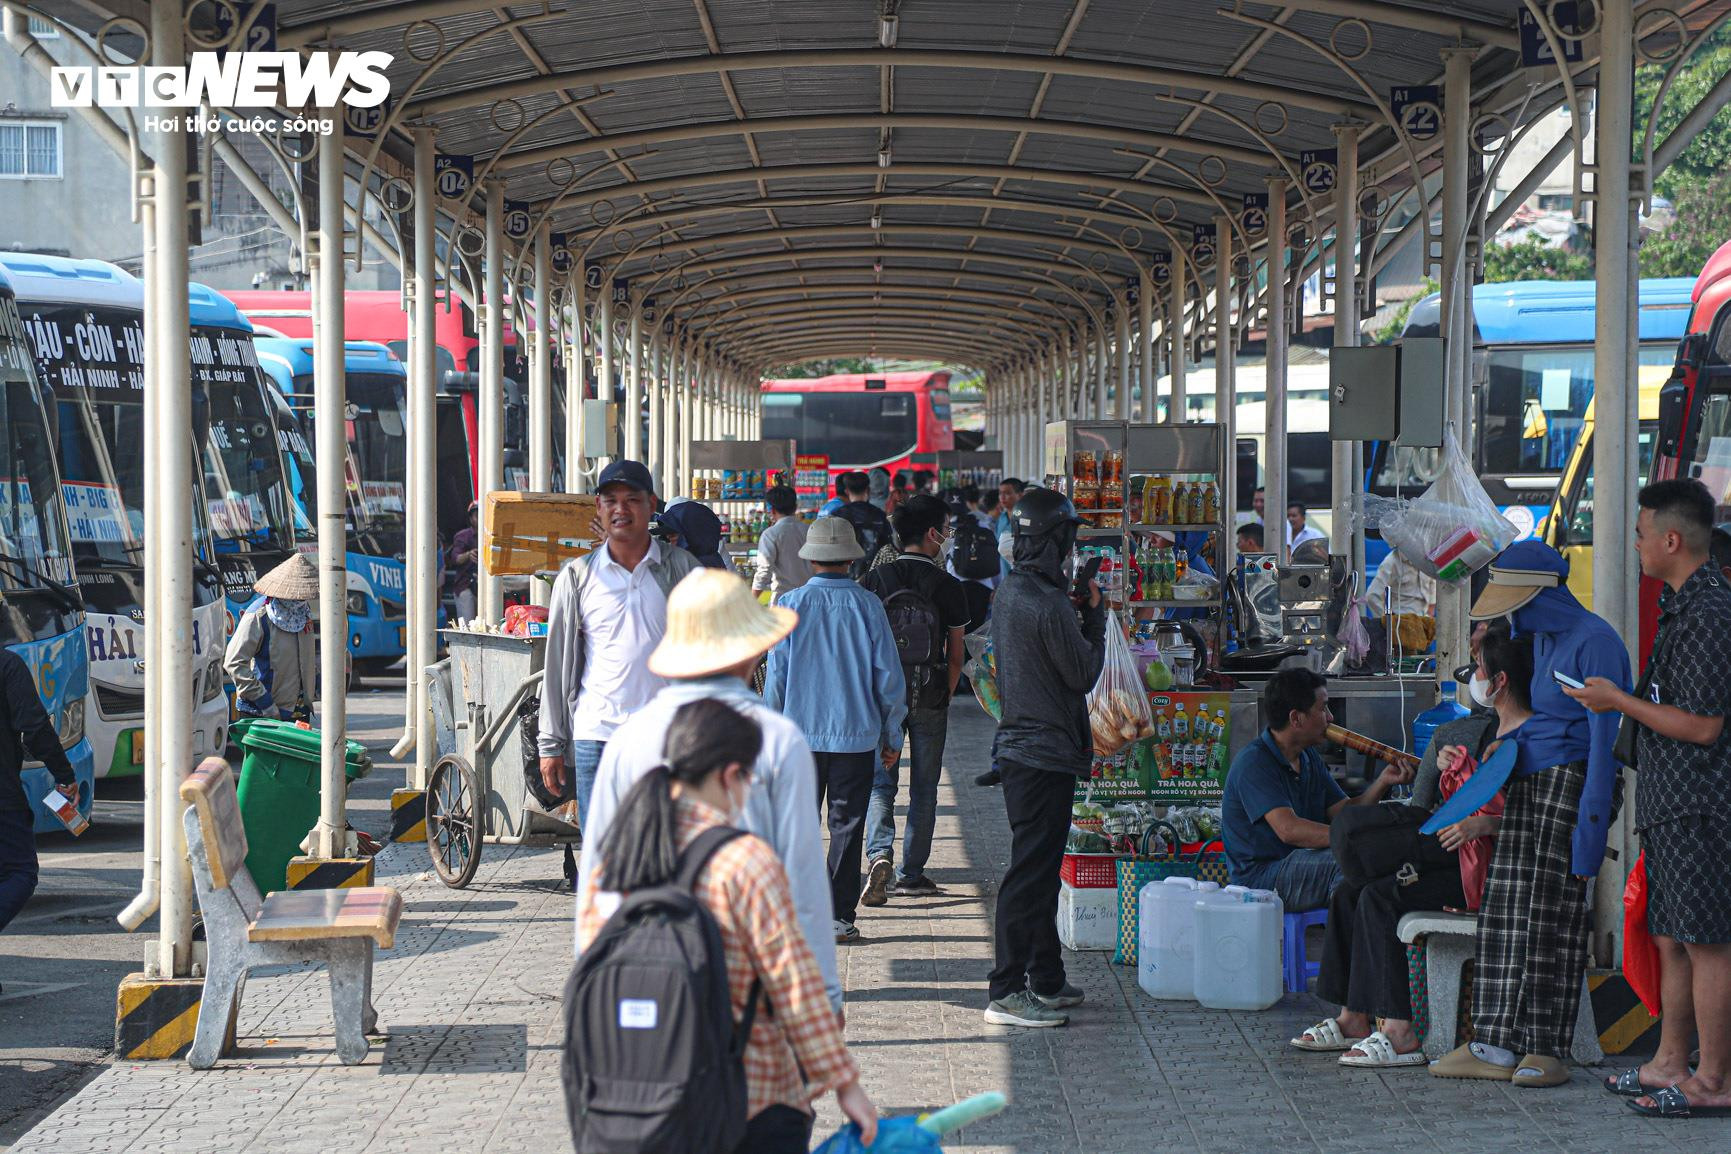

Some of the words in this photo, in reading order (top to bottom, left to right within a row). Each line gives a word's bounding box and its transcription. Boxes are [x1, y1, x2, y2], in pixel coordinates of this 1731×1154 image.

[1394, 90, 1409, 102] A1
[1400, 105, 1434, 129] 22
[436, 158, 452, 169] A2
[1303, 152, 1316, 163] A1
[60, 361, 86, 388] HẢI
[86, 368, 120, 389] NINH
[85, 487, 109, 510] BIG
[368, 562, 403, 590] VINH
[87, 616, 137, 662] HẢI
[1098, 780, 1118, 788] HOA
[1119, 778, 1140, 788] QUẢ
[1157, 777, 1176, 788] TRÀ
[1177, 780, 1198, 788] HOA
[1199, 778, 1220, 788] QUẢ
